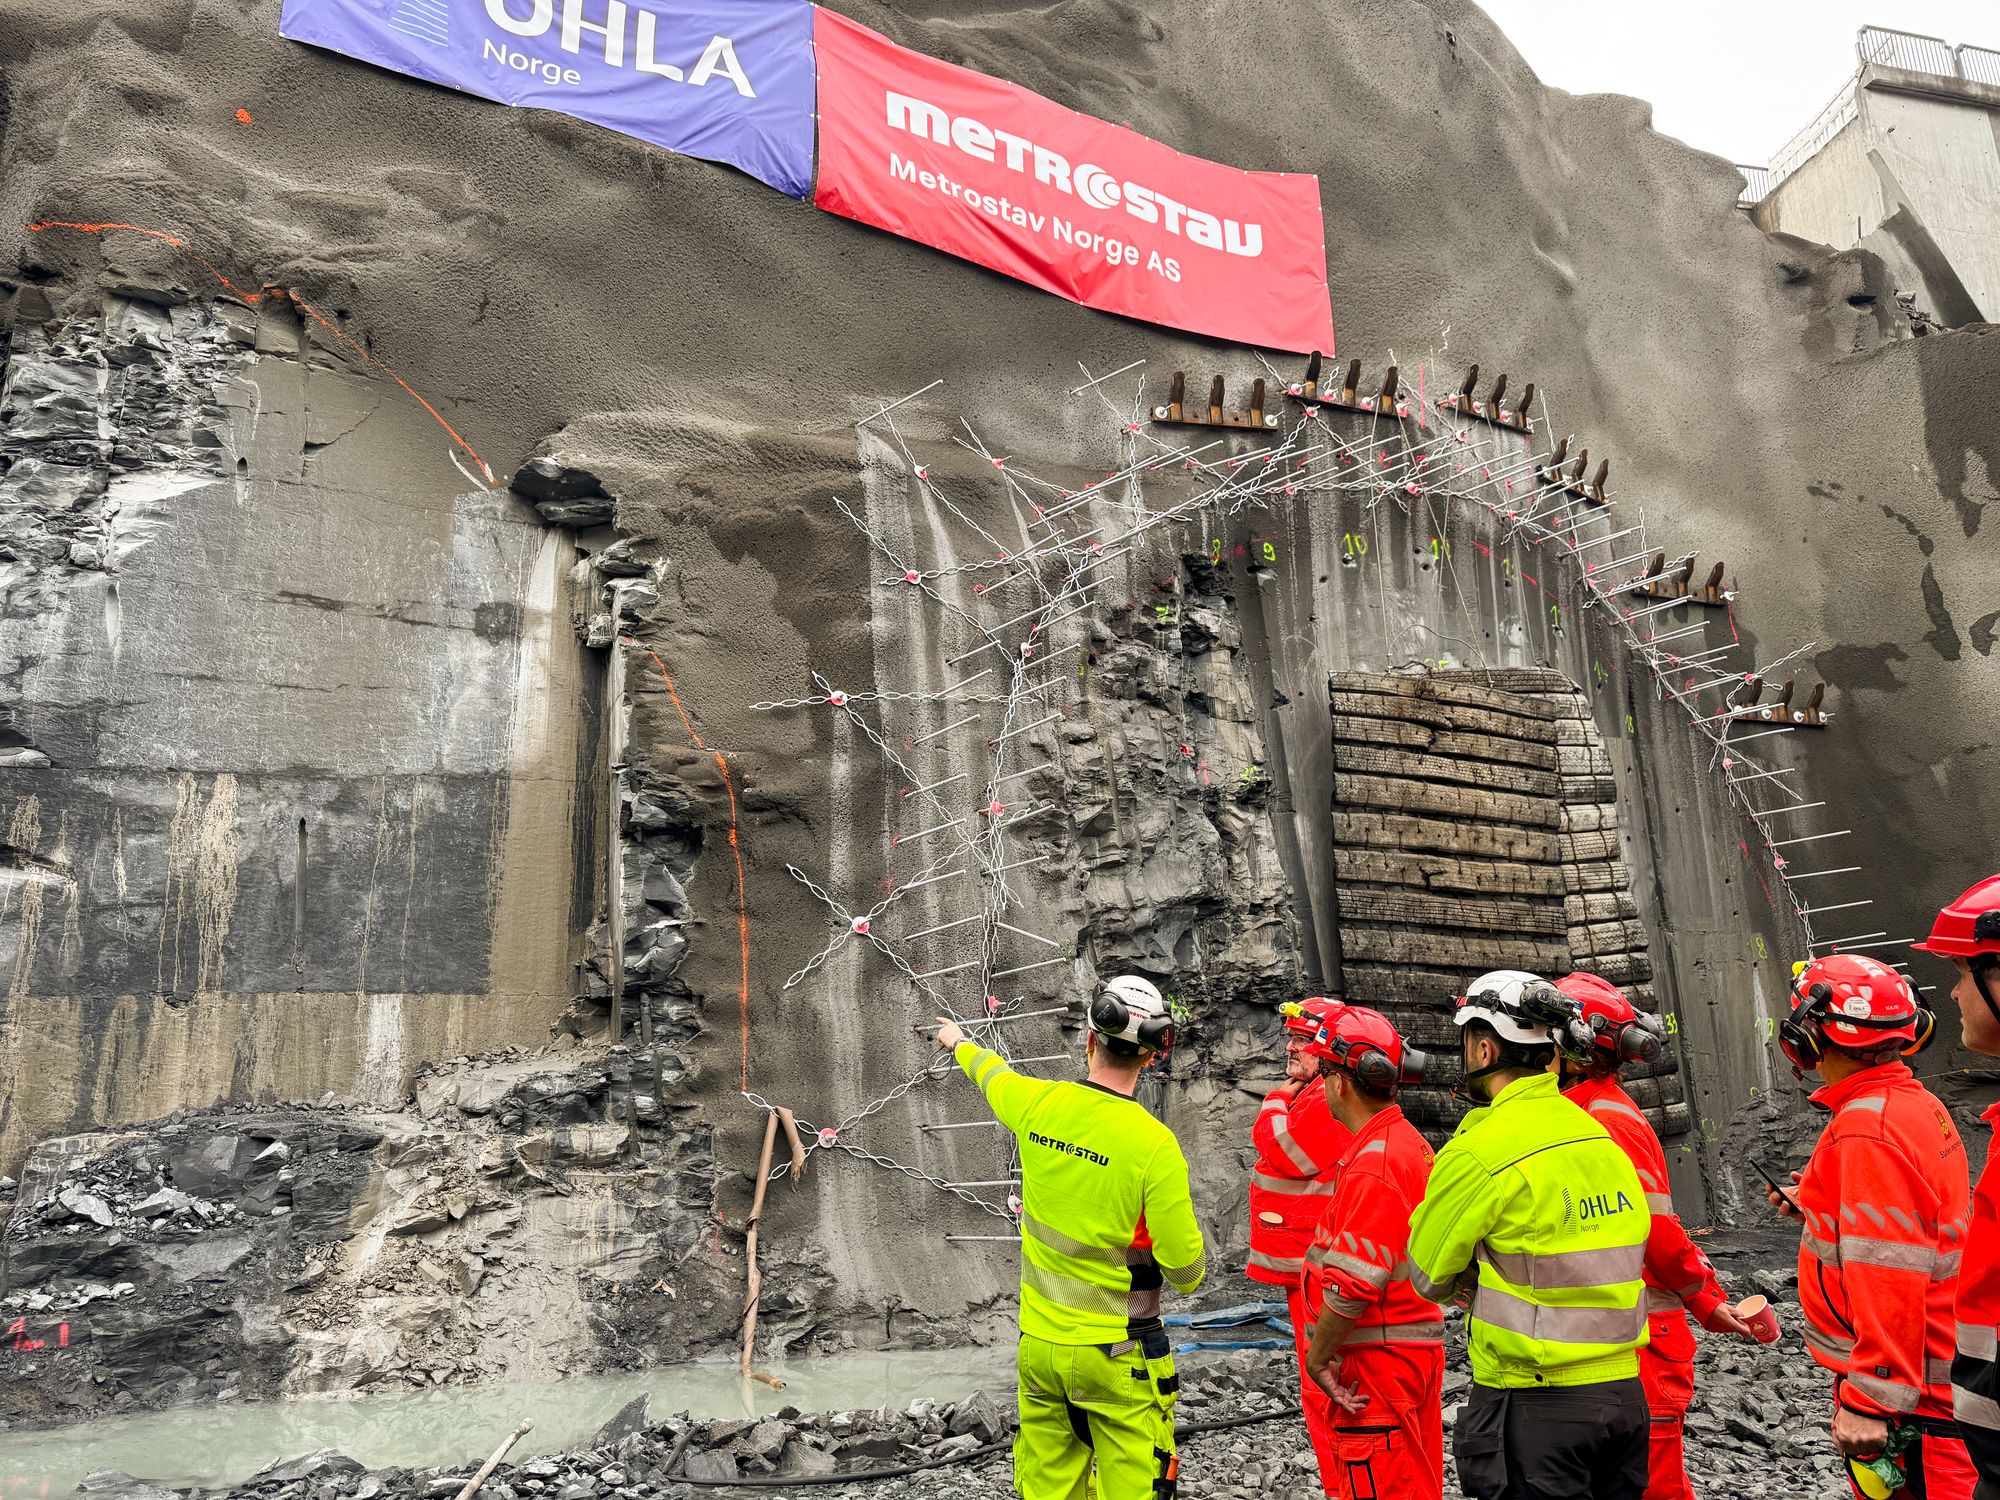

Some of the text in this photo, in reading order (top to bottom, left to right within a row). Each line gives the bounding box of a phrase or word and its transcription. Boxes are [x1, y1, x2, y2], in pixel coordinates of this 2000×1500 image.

[483, 38, 581, 85] Norge
[484, 0, 757, 98] OHLA
[889, 152, 1181, 283] Metrostav Norge AS
[1263, 542, 1276, 561] 9
[1340, 532, 1368, 556] 10
[1665, 1012, 1679, 1035] 33
[1580, 1191, 1634, 1220] OHLA
[1580, 1223, 1600, 1233] Norge
